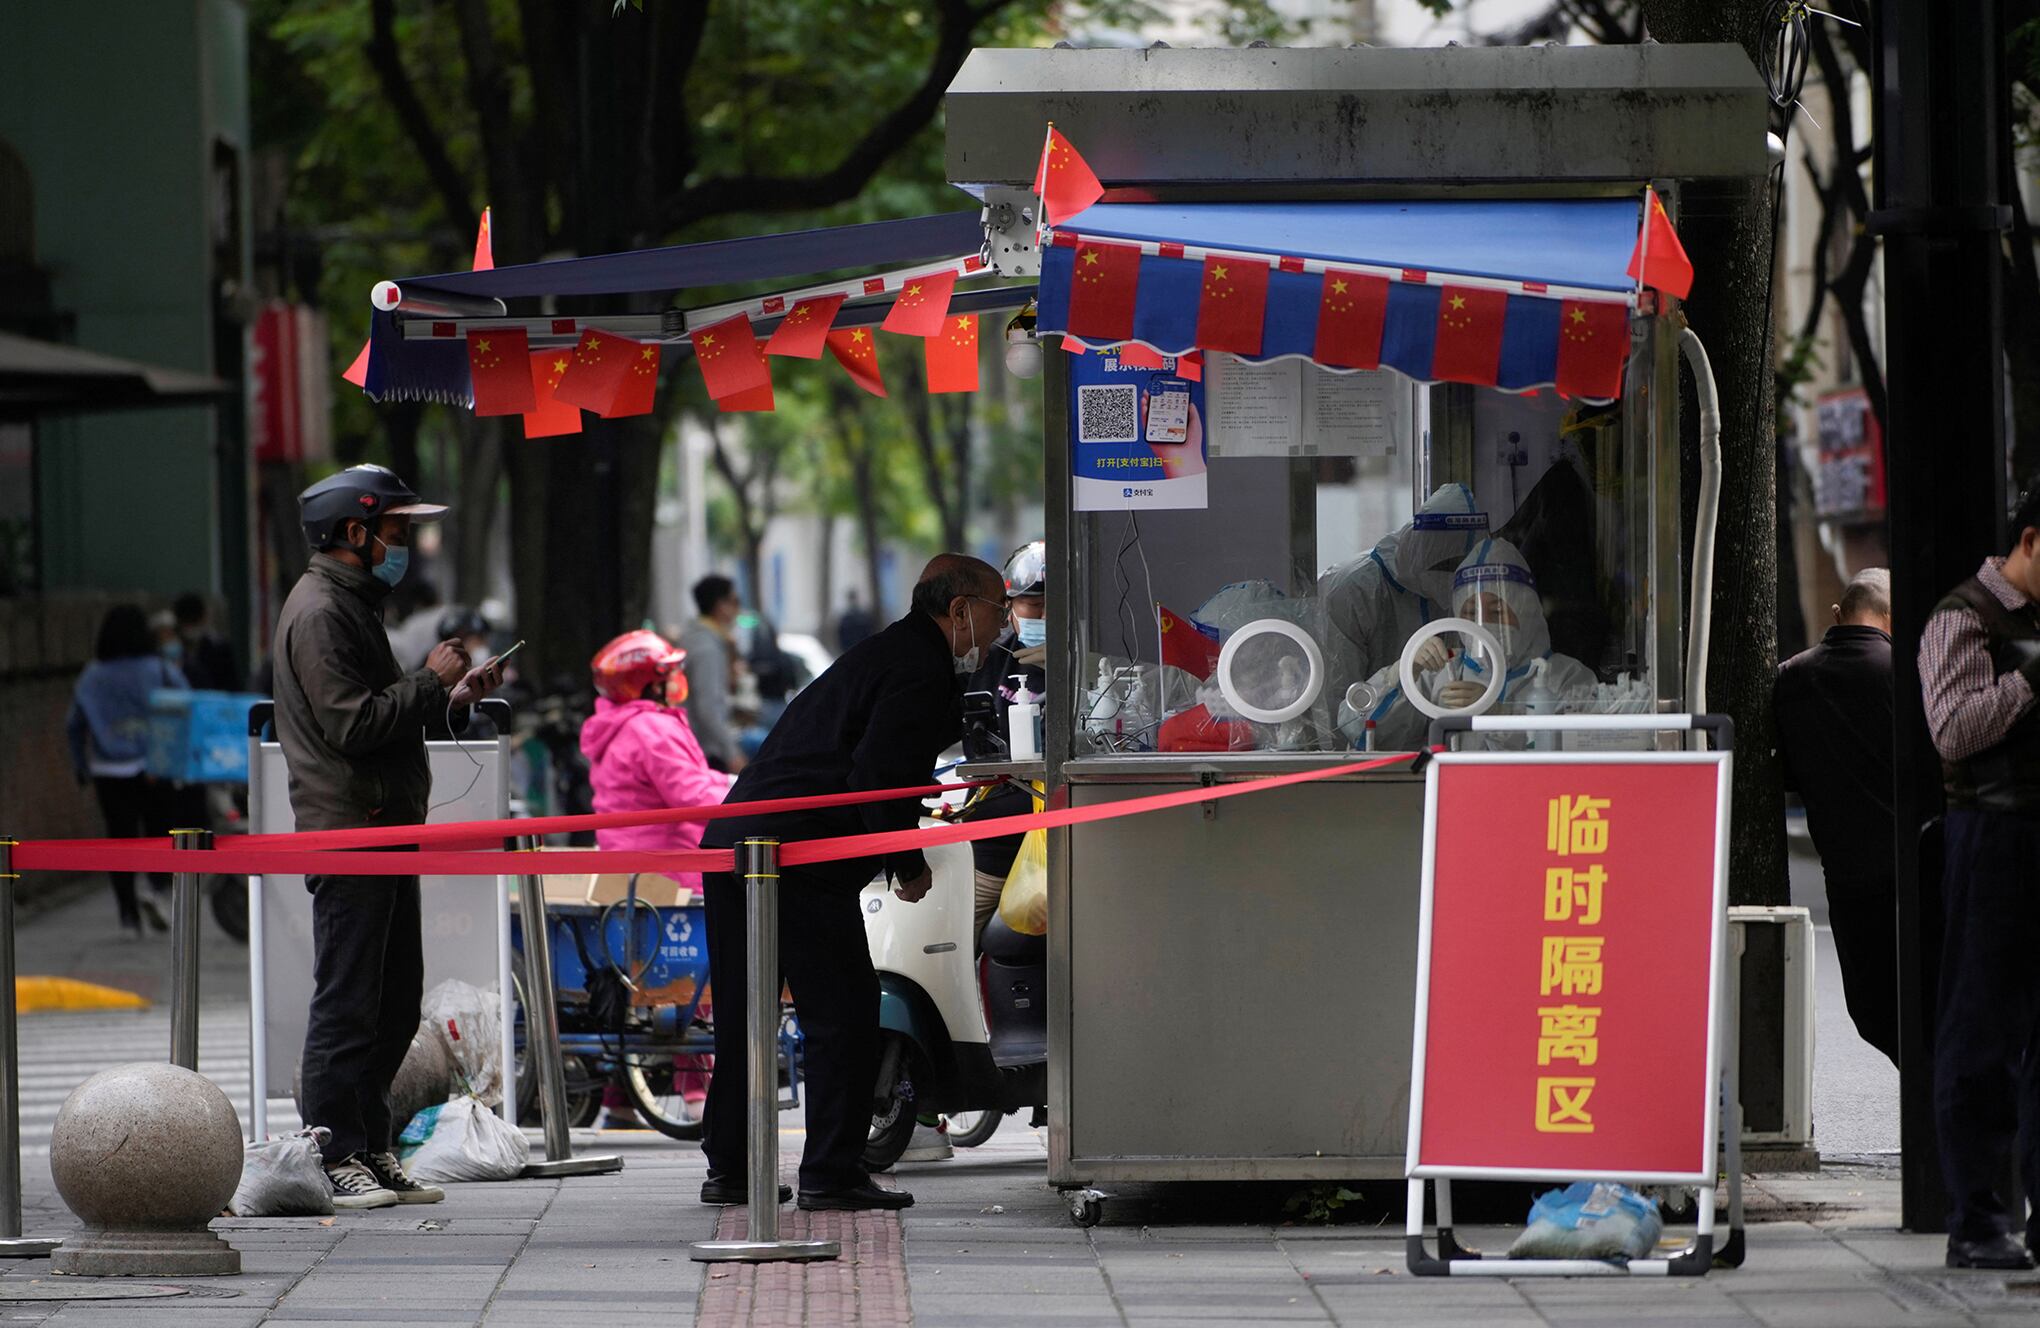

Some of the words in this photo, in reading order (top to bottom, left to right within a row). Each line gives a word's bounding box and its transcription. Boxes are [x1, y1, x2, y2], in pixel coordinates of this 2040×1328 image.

[1535, 794, 1611, 1134] 临时隔离区
